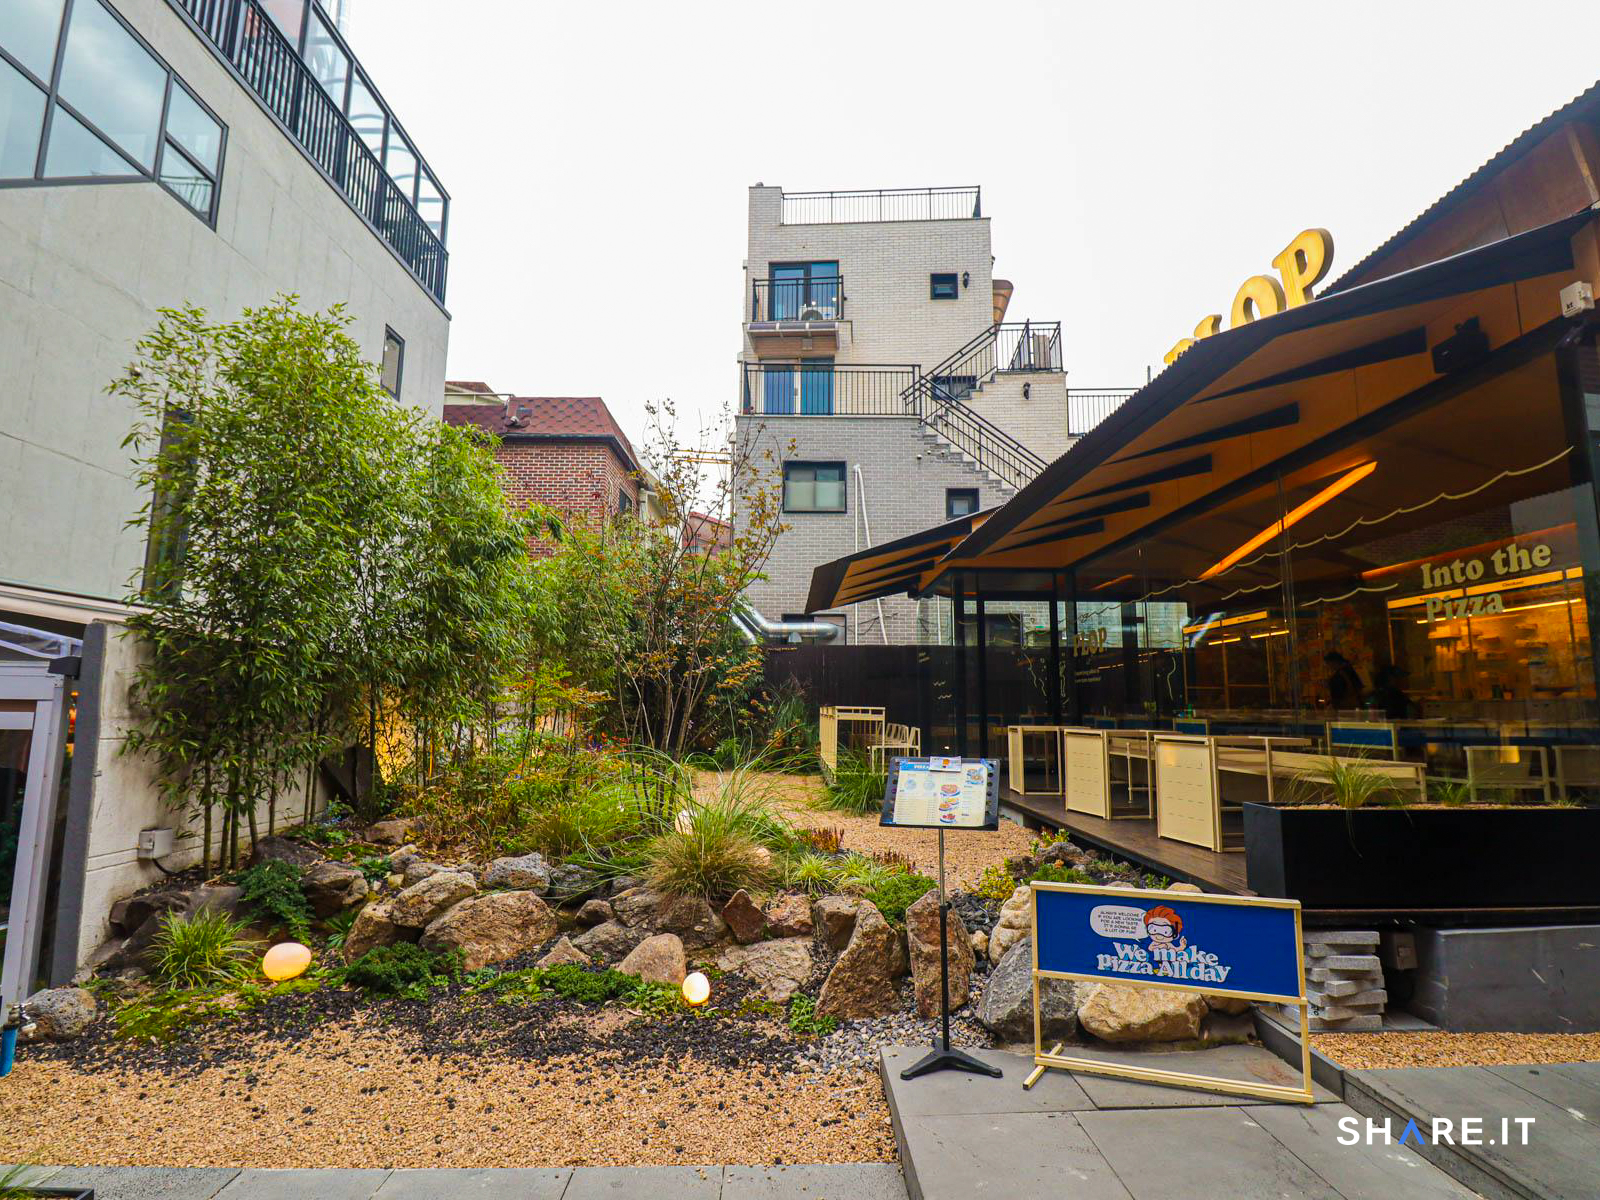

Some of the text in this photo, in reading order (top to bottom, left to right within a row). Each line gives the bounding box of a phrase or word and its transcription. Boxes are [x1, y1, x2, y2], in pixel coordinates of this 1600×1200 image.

[1164, 228, 1335, 364] OP
[1420, 543, 1552, 589] Into the
[1426, 593, 1504, 622] Pizza
[1113, 942, 1219, 966] We make
